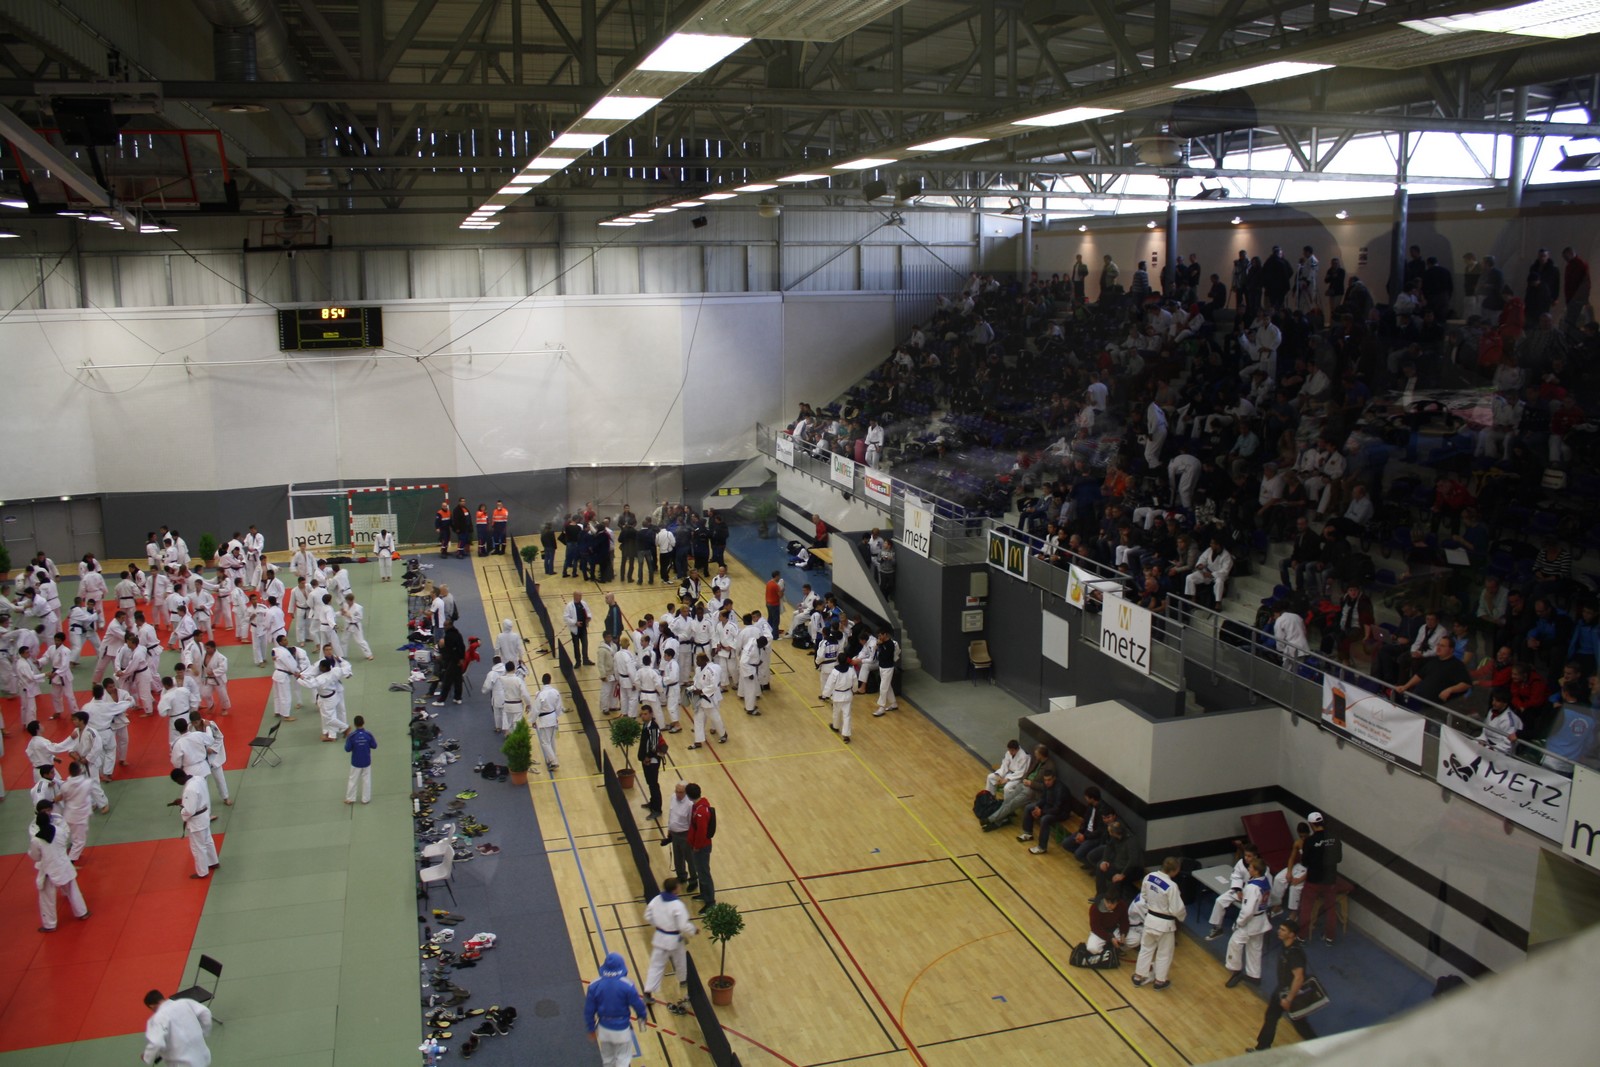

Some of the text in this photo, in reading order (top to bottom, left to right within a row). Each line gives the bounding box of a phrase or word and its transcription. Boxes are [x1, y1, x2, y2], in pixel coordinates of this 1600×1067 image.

[904, 528, 928, 553] metz
[1102, 627, 1147, 669] metz
[1484, 761, 1563, 808] METZ
